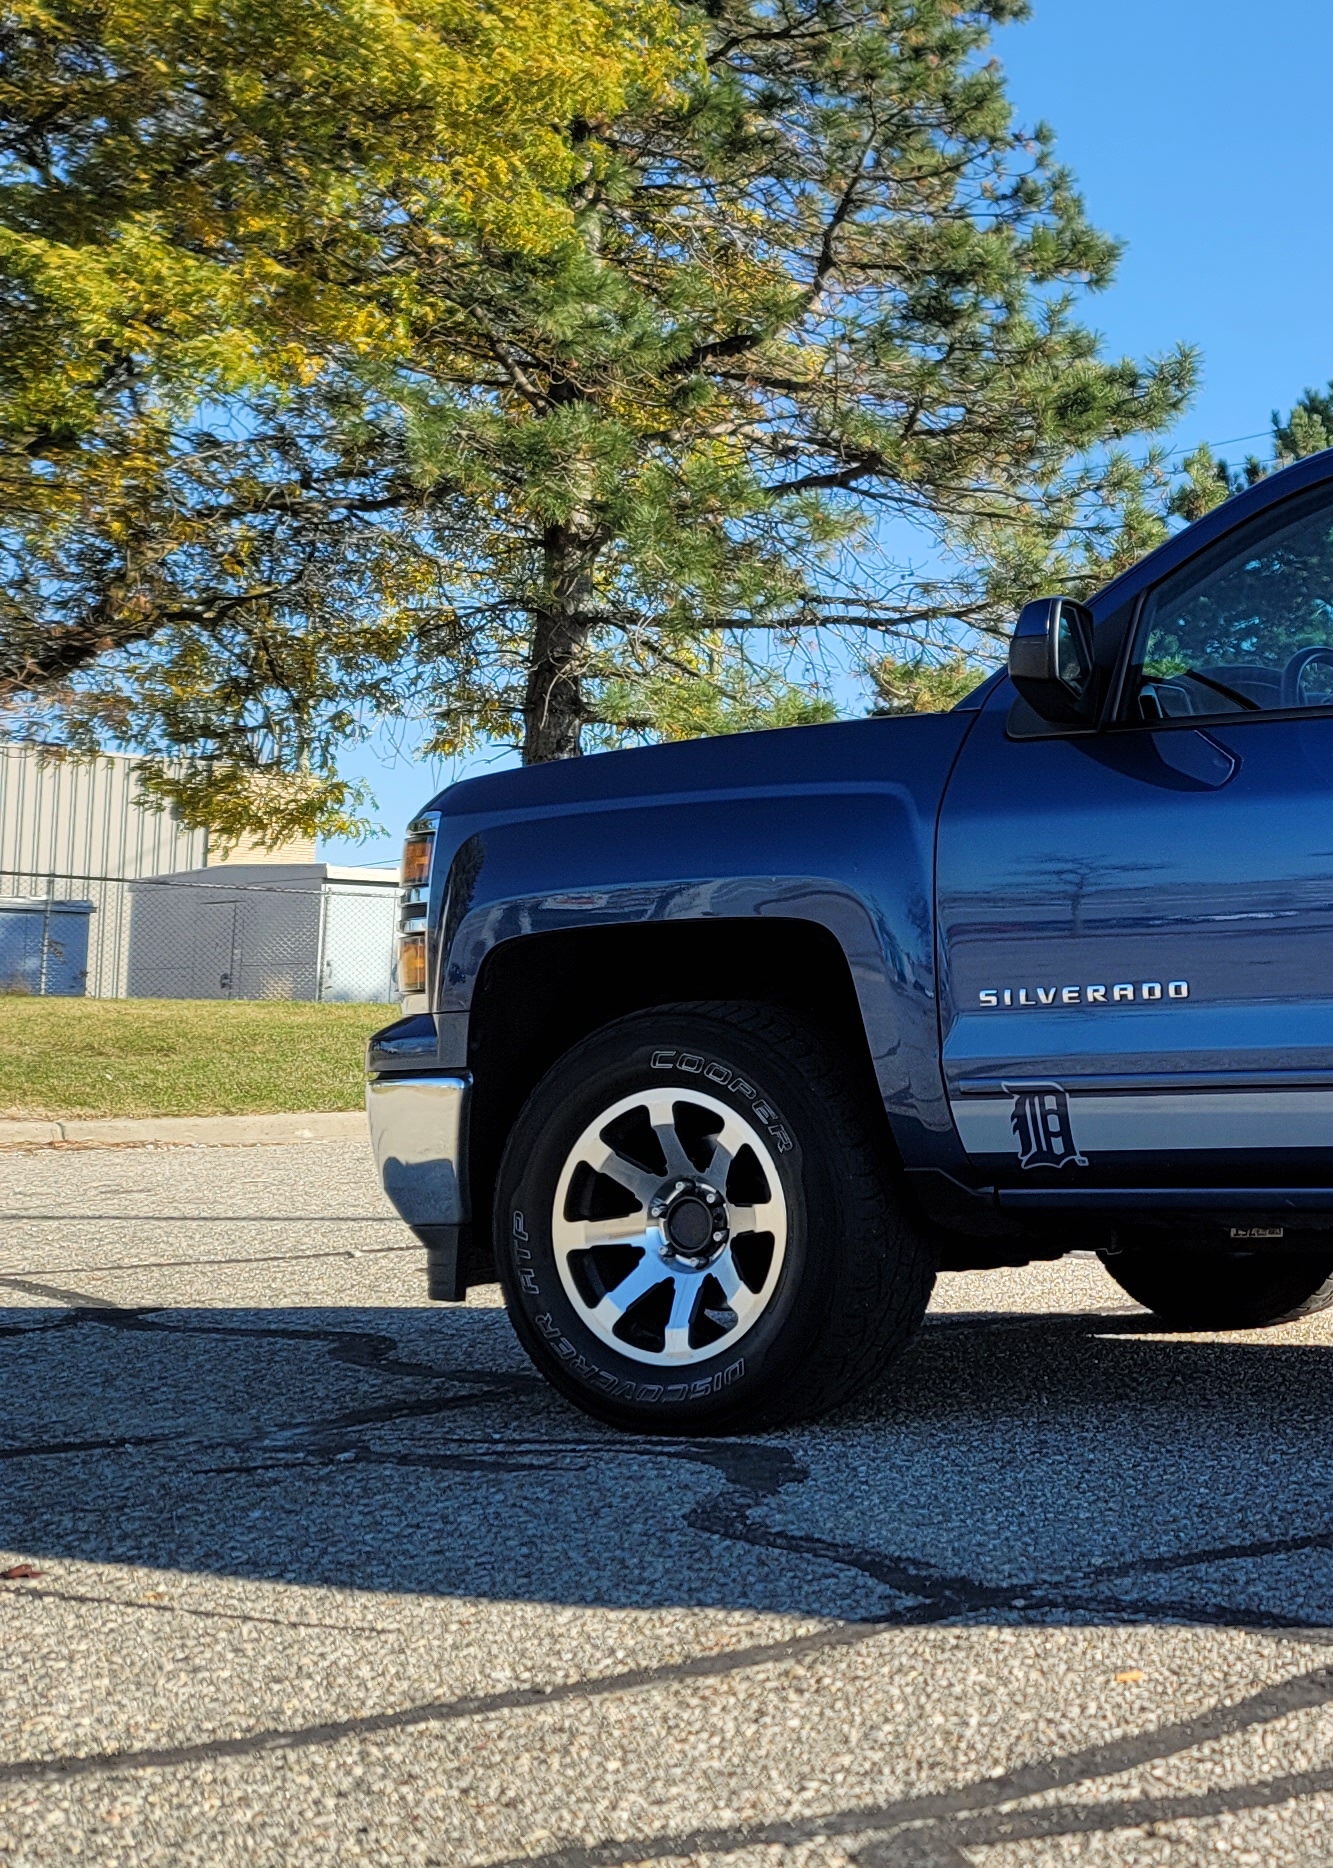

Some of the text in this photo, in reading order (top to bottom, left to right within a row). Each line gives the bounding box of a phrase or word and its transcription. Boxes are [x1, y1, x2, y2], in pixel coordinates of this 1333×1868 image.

[979, 980, 1190, 1007] SILVERADO
[650, 1049, 794, 1155] COOPER
[511, 1209, 746, 1403] DISCOVERER ATP
